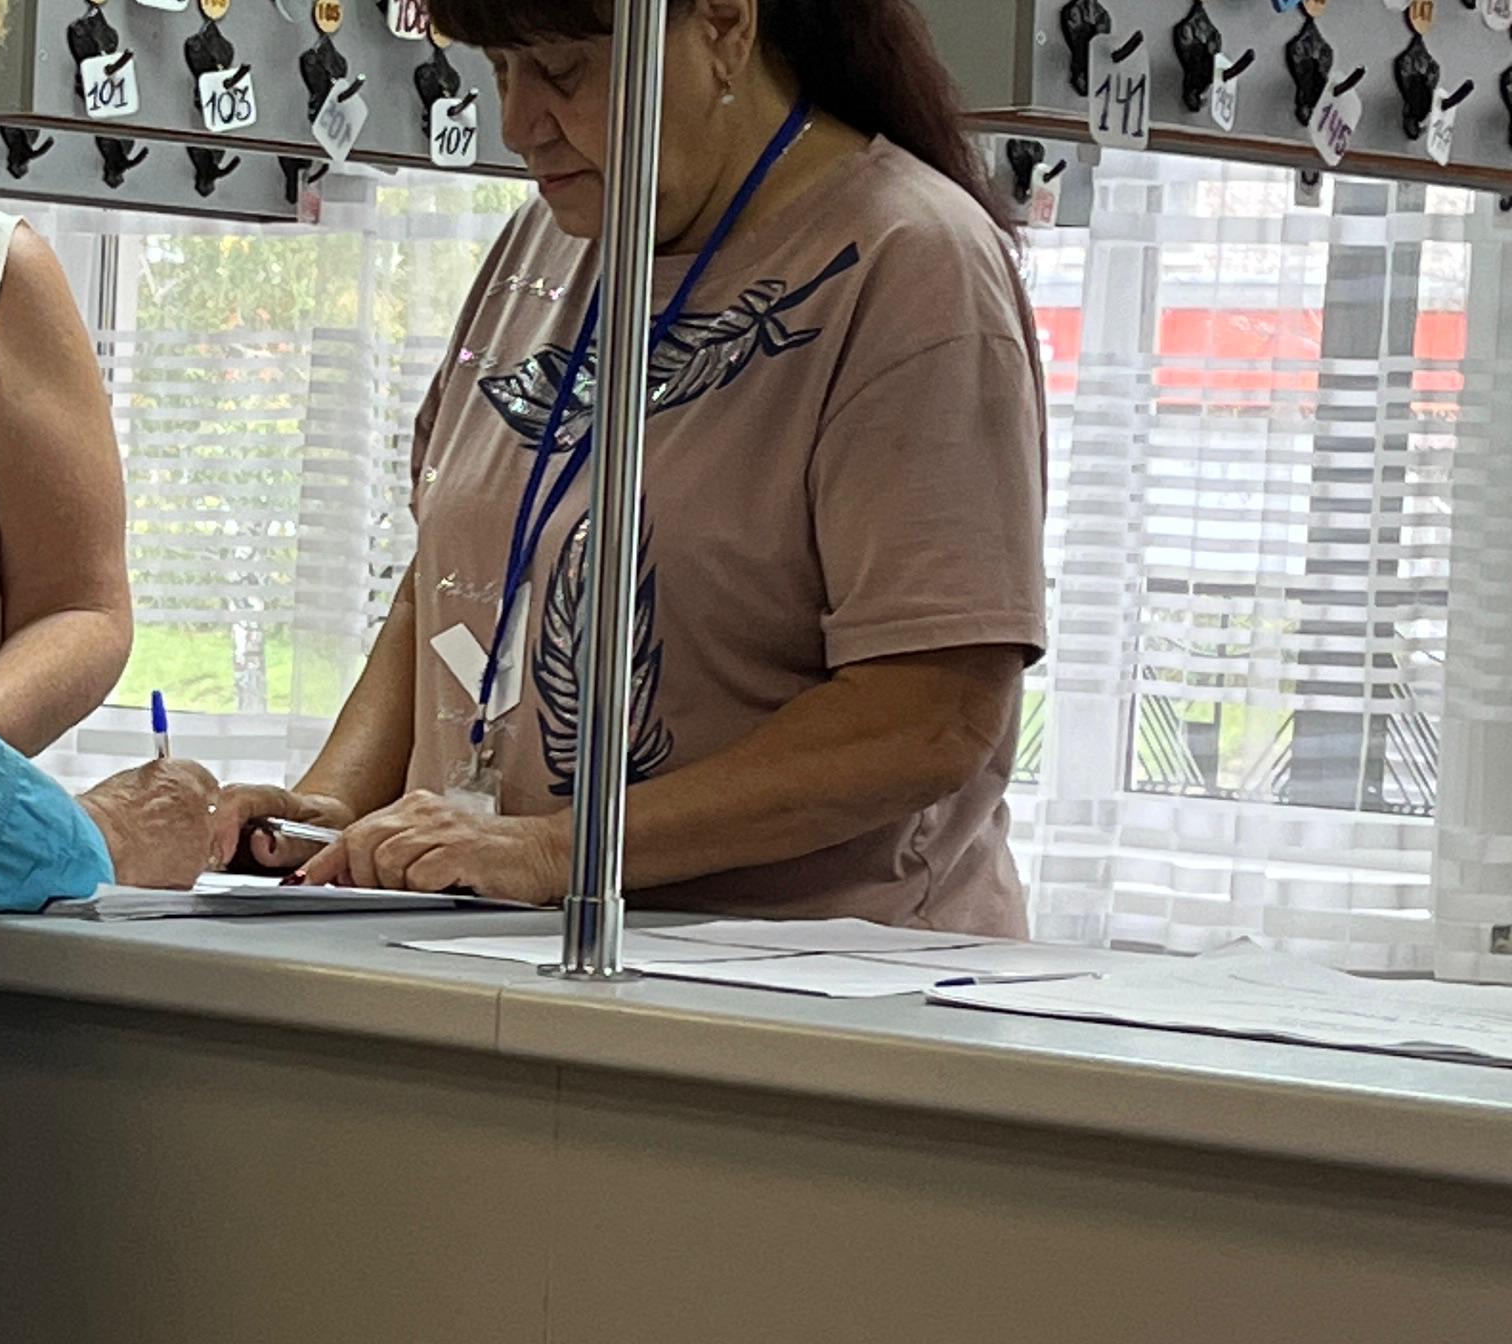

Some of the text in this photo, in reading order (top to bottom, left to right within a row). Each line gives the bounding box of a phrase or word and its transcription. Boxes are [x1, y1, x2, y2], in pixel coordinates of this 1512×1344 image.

[88, 77, 128, 110] 101
[206, 86, 251, 126] 103
[1094, 72, 1146, 137] 141
[435, 126, 476, 156] 107
[1318, 103, 1352, 157] 145
